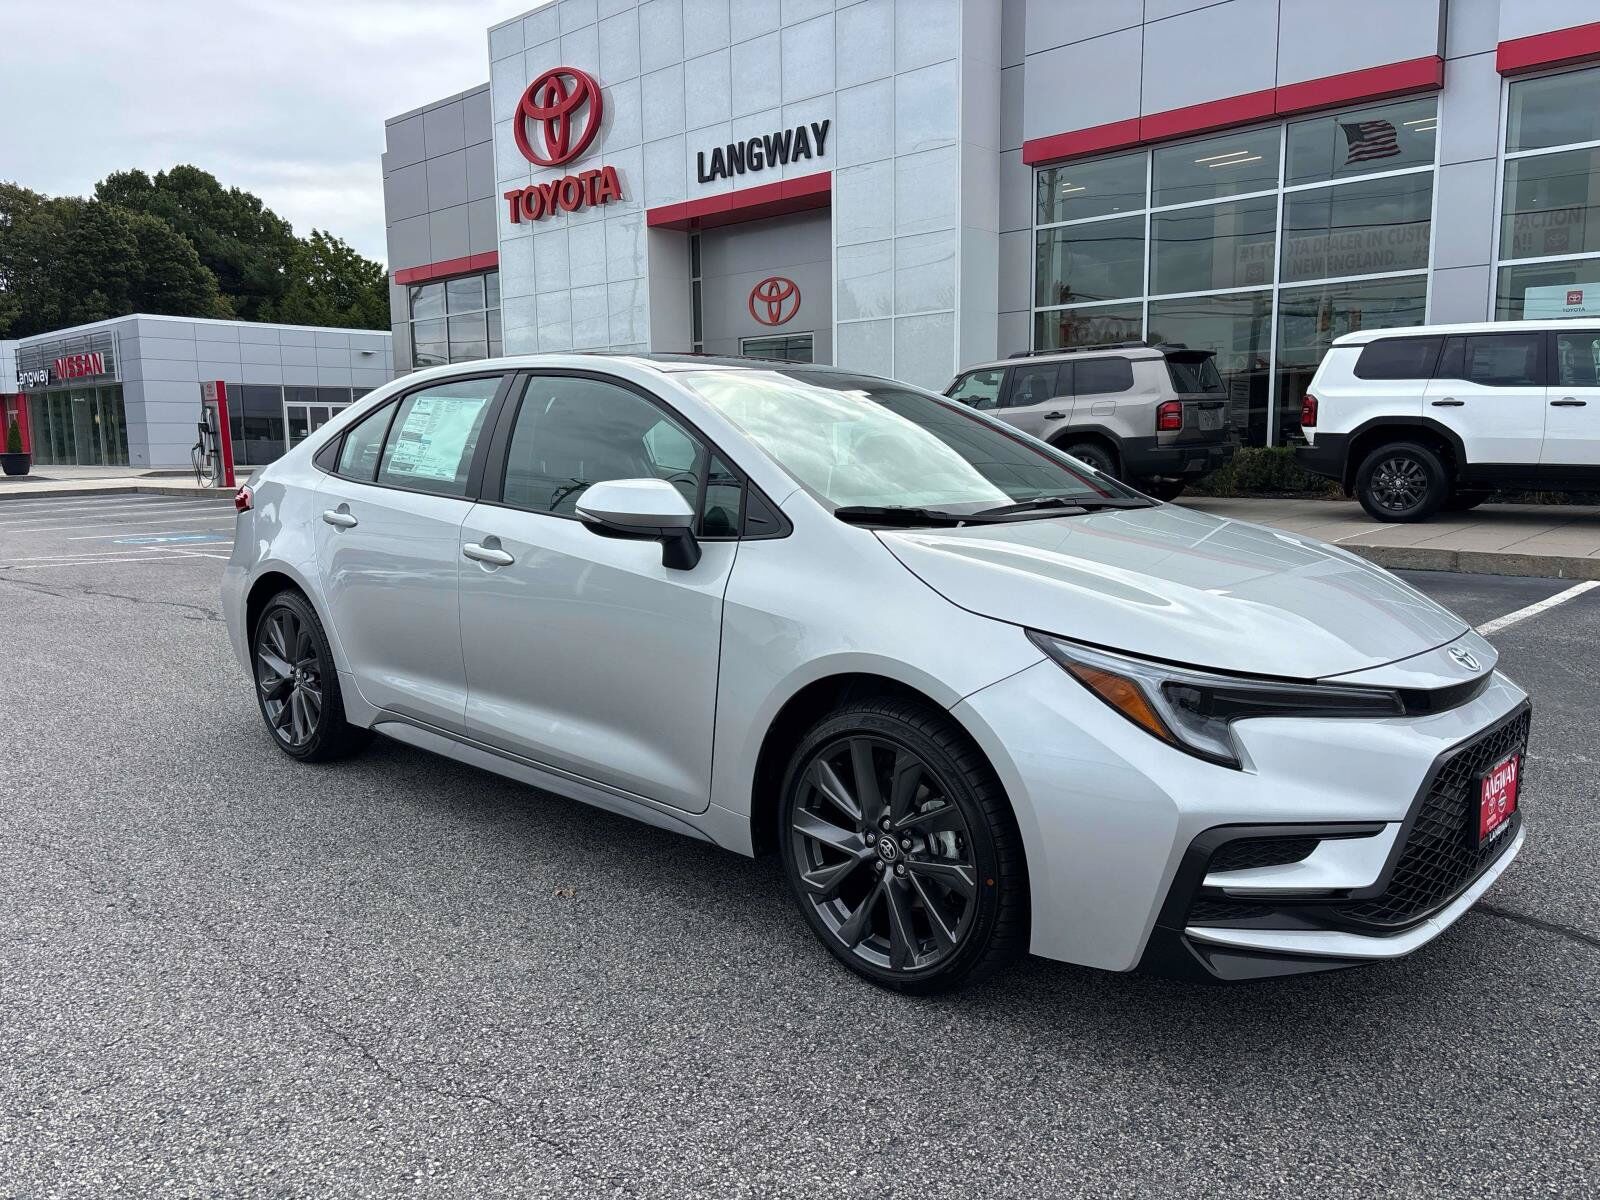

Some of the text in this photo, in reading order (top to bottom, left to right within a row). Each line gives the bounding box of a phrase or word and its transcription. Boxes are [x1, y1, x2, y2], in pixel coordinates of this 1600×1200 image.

[697, 119, 831, 183] LANGWAY
[504, 166, 622, 223] TOYOTA
[1313, 233, 1362, 252] DEALER
[1366, 230, 1382, 247] IN
[1293, 256, 1323, 276] NEW
[16, 369, 49, 388] Langway
[56, 352, 103, 379] NISSAN
[1481, 760, 1517, 806] LANGWAY
